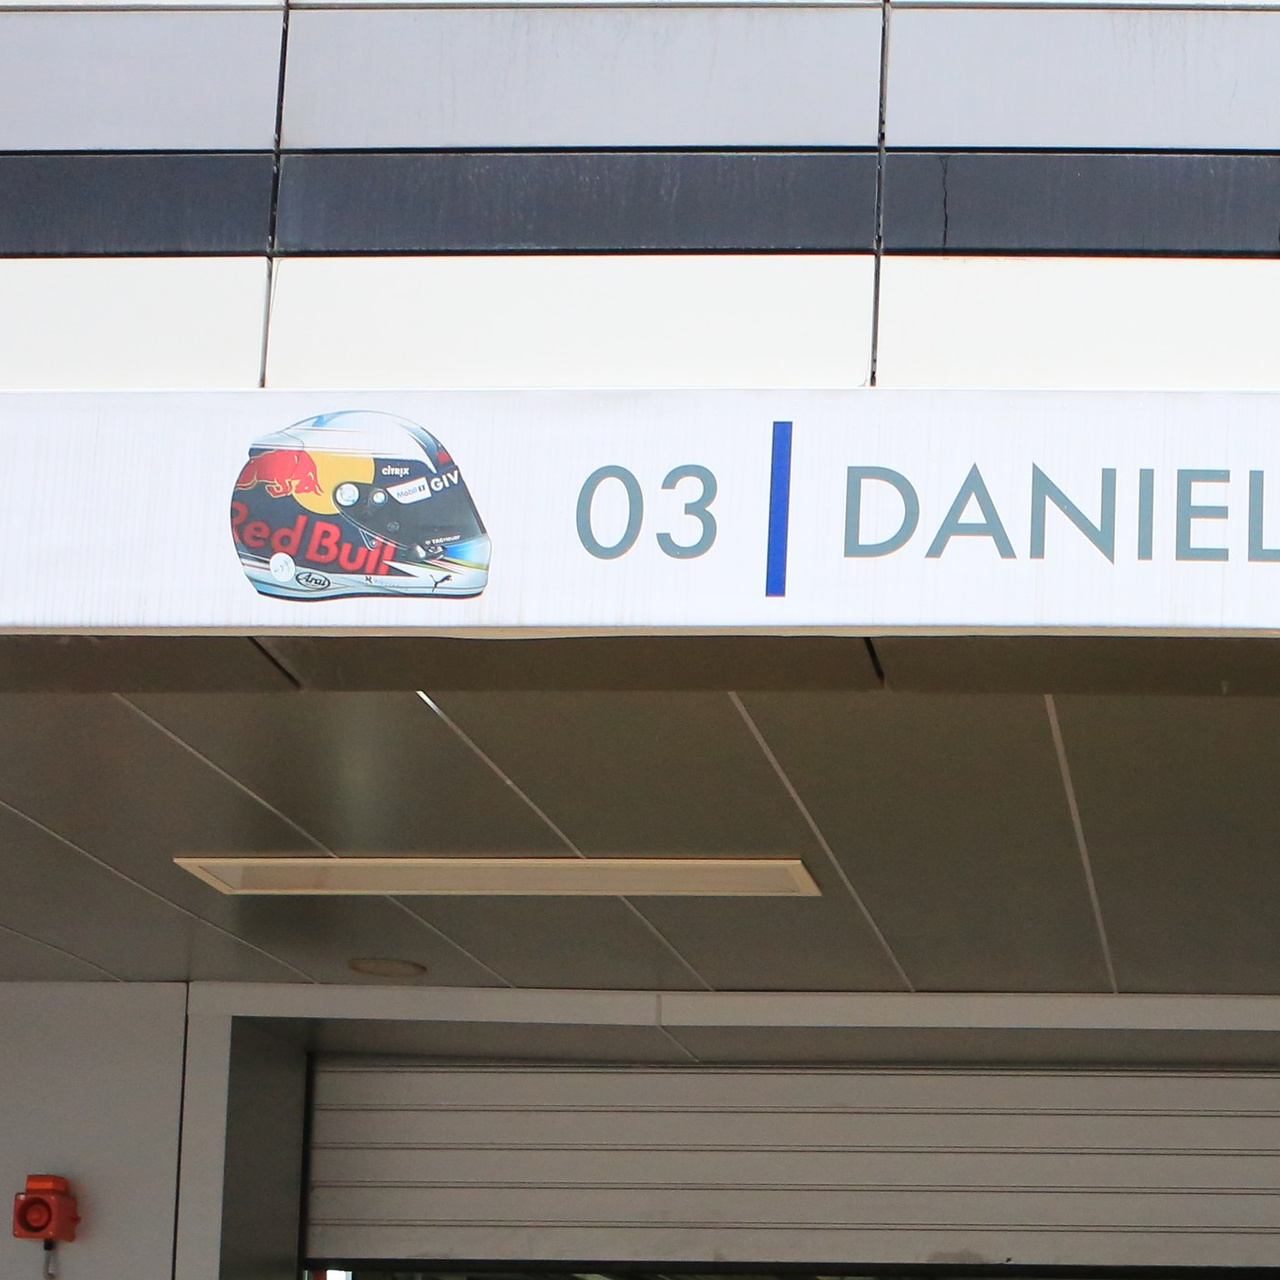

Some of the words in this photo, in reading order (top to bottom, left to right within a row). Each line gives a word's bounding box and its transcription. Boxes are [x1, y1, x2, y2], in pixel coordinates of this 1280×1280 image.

[576, 464, 718, 560] 03
[305, 521, 396, 576] Bull
[301, 573, 327, 587] Arai
